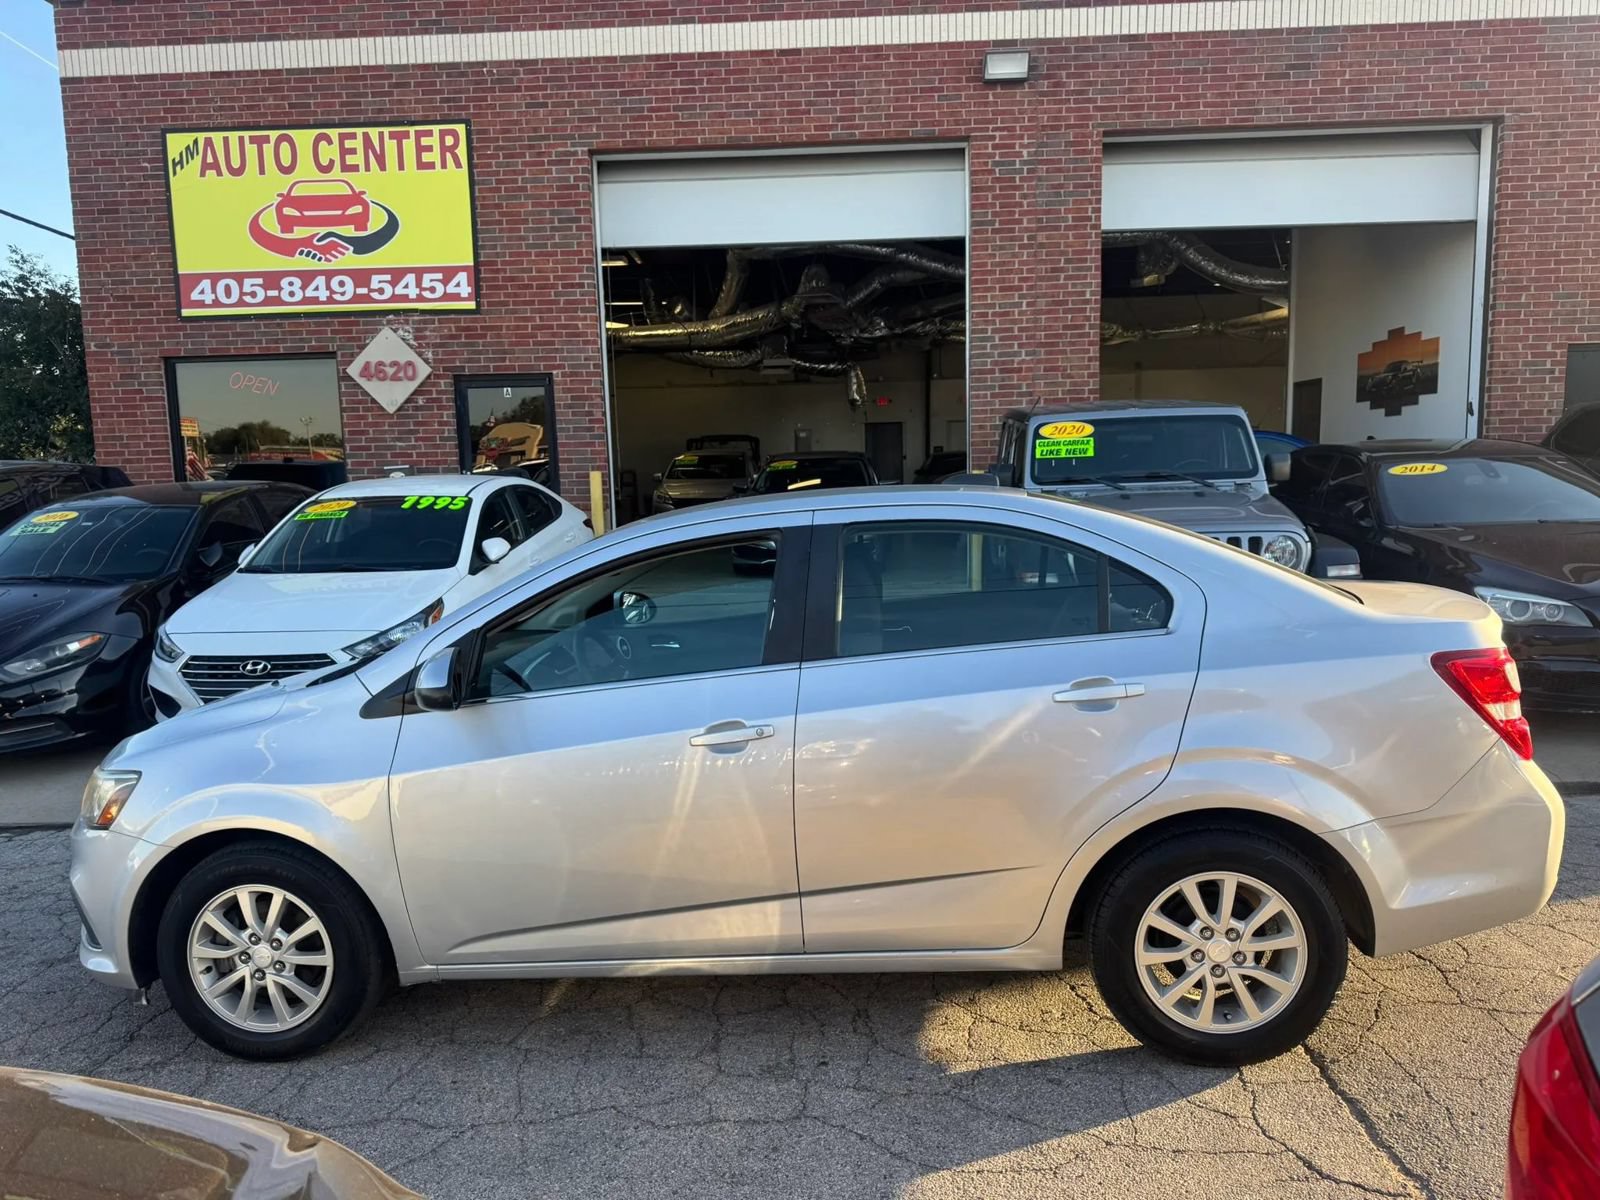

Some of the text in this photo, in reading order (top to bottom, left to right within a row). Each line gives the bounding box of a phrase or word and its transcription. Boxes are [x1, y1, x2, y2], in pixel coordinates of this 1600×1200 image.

[171, 128, 463, 177] HM AUTO CENTER
[190, 271, 472, 305] 405-849-5454
[359, 360, 417, 381] 4620
[230, 371, 280, 396] OPEN
[504, 388, 512, 397] A
[1048, 425, 1086, 436] 2020
[1040, 447, 1089, 456] LIKE NEW
[1400, 464, 1437, 473] 2014
[401, 496, 469, 510] 7995
